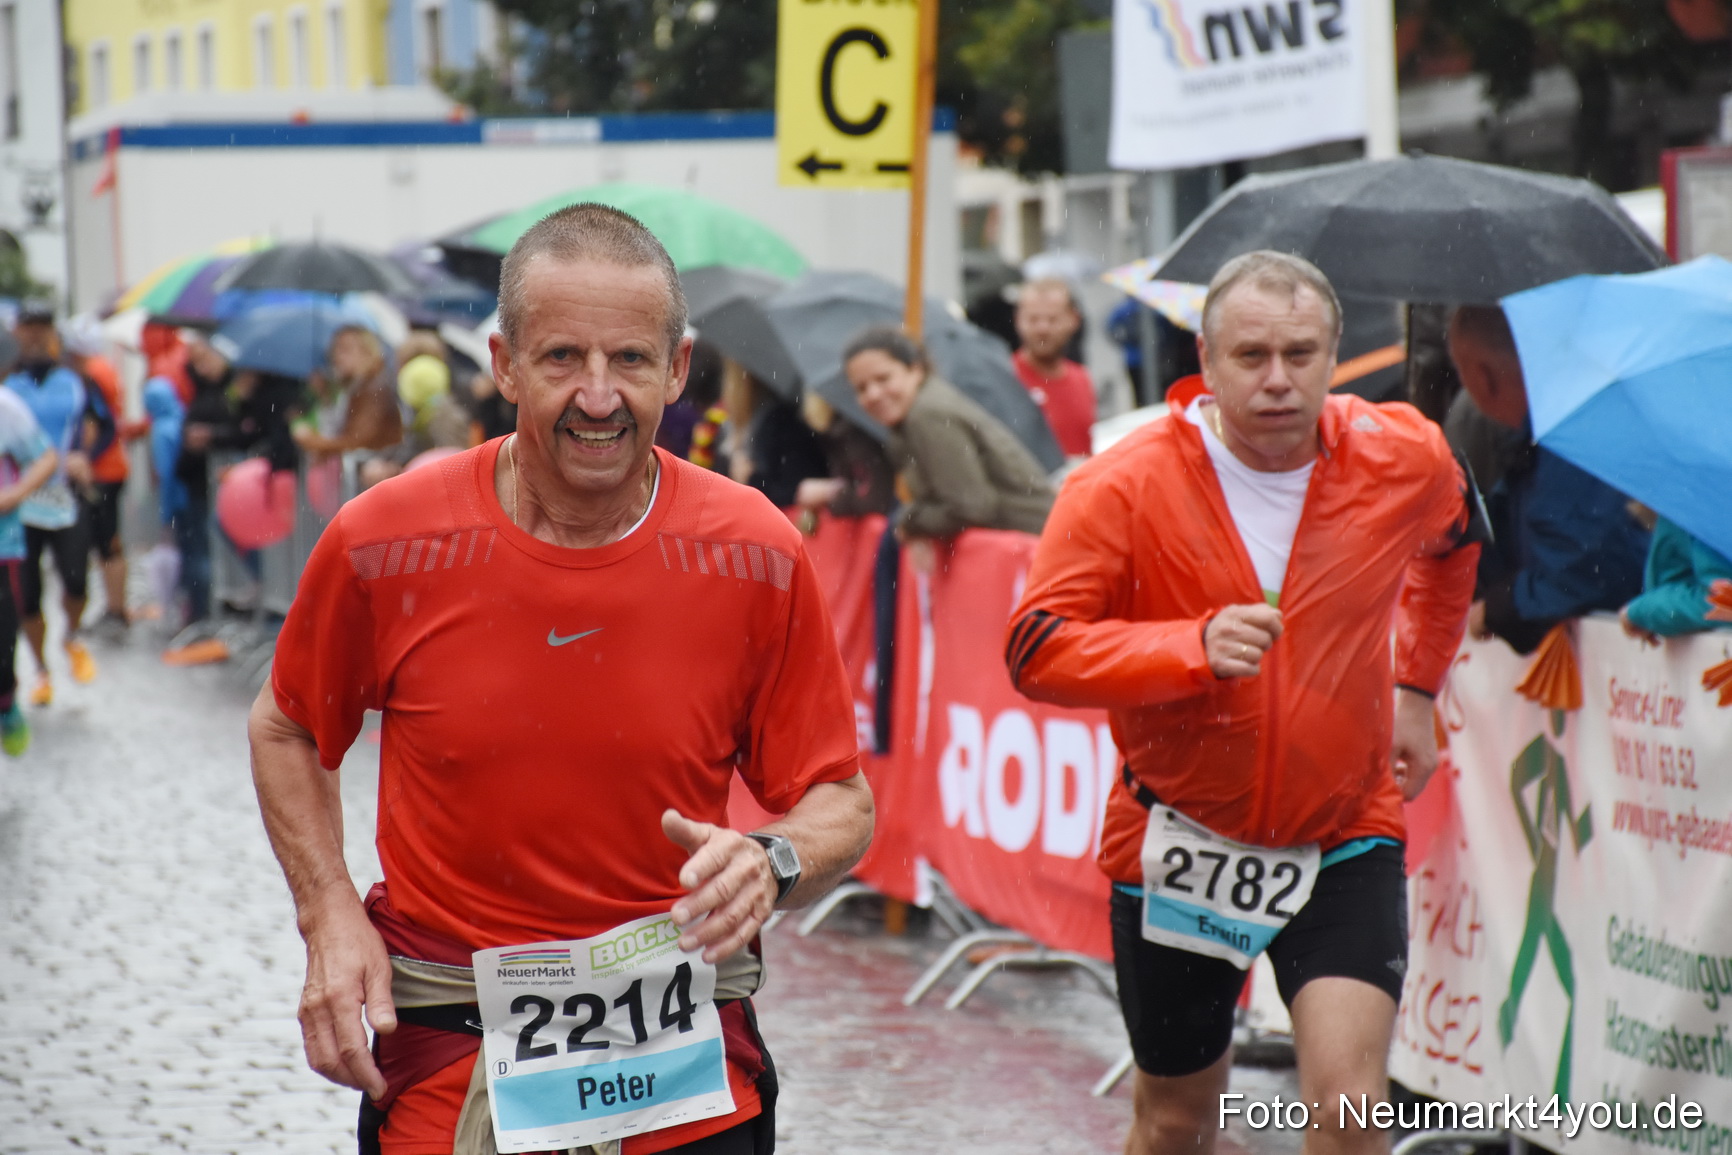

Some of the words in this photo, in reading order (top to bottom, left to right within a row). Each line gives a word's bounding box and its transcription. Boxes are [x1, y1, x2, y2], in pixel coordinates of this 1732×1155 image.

[819, 28, 890, 136] C
[1162, 846, 1302, 920] 2782
[656, 942, 680, 957] concep
[1197, 914, 1251, 952] Erwin
[497, 966, 577, 978] NeuerMarkt
[510, 961, 698, 1062] 2214
[498, 1061, 508, 1075] D
[577, 1072, 656, 1111] Peter
